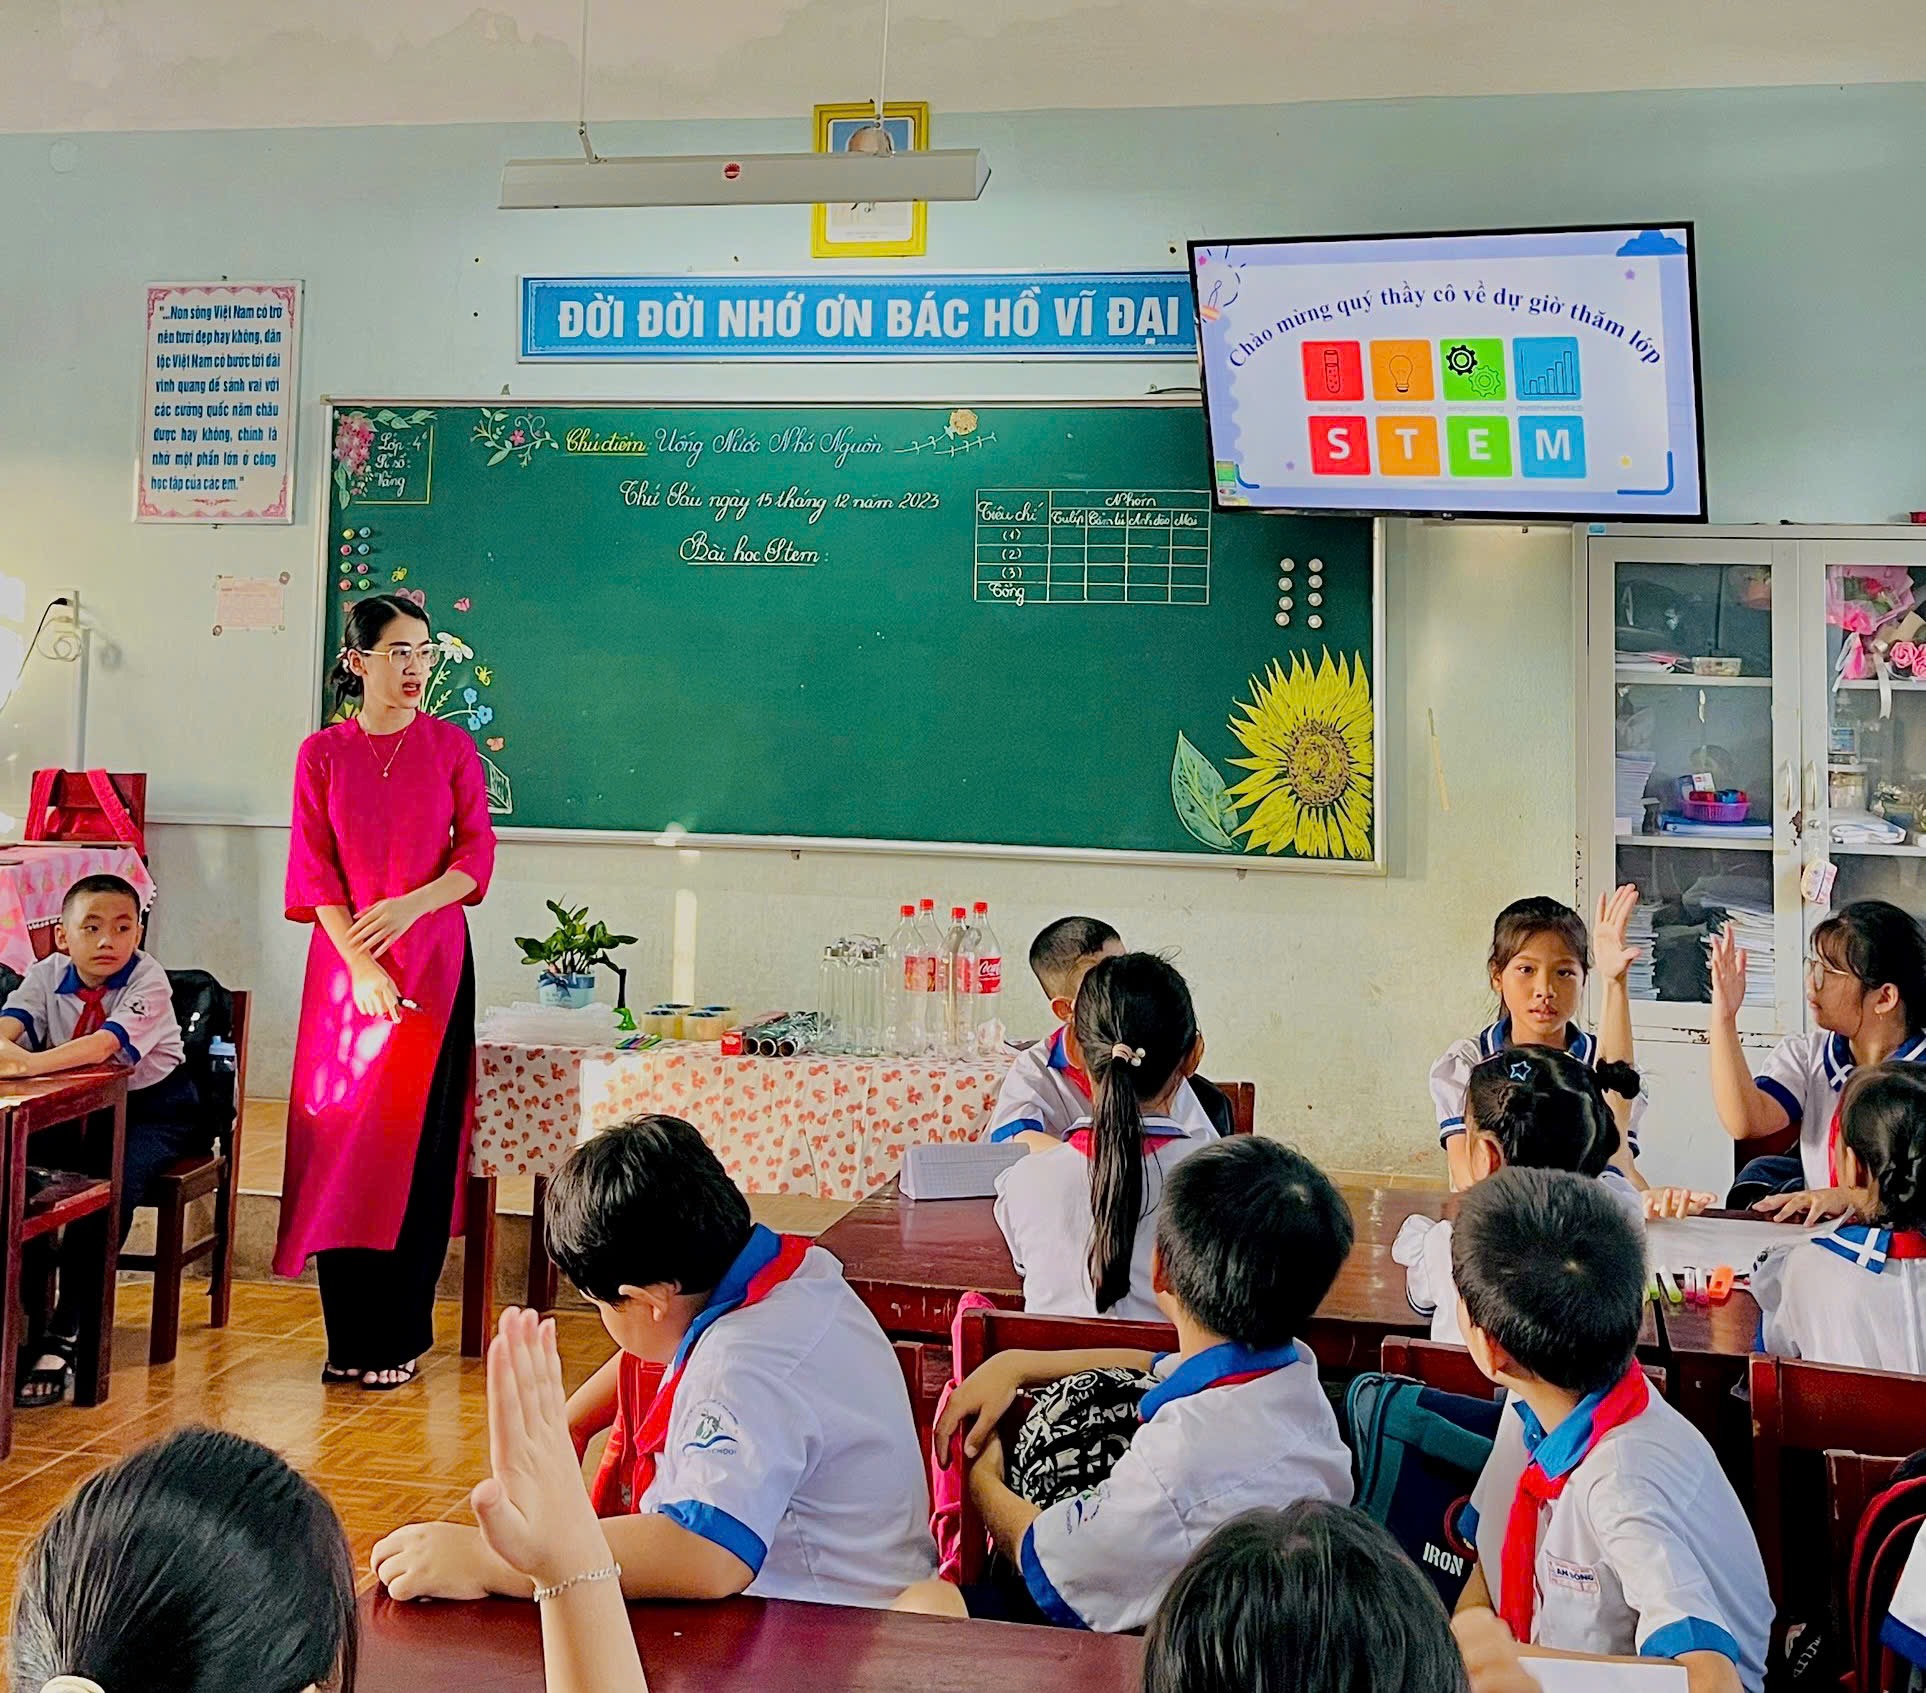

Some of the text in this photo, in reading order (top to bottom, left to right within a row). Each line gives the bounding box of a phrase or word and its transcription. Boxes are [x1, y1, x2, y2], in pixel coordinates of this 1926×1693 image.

[214, 305, 231, 321] Việt
[233, 305, 254, 319] Nam
[256, 304, 267, 319] có
[269, 302, 283, 319] trở
[557, 286, 1179, 345] ĐỜI ĐỜI NHỚ ƠN BÁC HỒ VĨ ĐẠI
[1228, 280, 1661, 367] Chào mừng quý thầy cô về dự giờ thăm lớp
[157, 329, 174, 343] nên
[176, 331, 194, 343] tươi
[214, 330, 230, 344] hay
[156, 354, 171, 371] tộc
[172, 354, 190, 371] Việt
[192, 354, 212, 368] Nam
[214, 353, 225, 368] có
[227, 352, 250, 368] bước
[252, 352, 264, 367] tới
[156, 379, 175, 392] vinh
[178, 381, 206, 394] quang
[223, 378, 245, 392] sánh
[248, 379, 262, 392] vai
[265, 378, 280, 392] với
[154, 401, 279, 418] các cường quốc năm châu
[181, 427, 197, 442] hay
[238, 426, 264, 441] chính
[268, 427, 278, 441] là
[566, 427, 600, 452] Chủ
[654, 428, 704, 468] Uống
[712, 427, 760, 454] Nước
[769, 426, 815, 454] Nhớ
[819, 426, 884, 468] Nguồn
[1327, 427, 1571, 461] S T E M
[175, 451, 193, 468] một
[223, 451, 239, 466] lớn
[253, 451, 277, 467] công
[151, 476, 168, 492] học
[169, 475, 183, 493] tập
[185, 474, 204, 490] của
[204, 476, 220, 490] các
[619, 480, 939, 524] Thứ Sáu ngày 15 tháng 12 năm 2023
[1105, 492, 1156, 506] Nhóm
[977, 501, 1044, 521] Tiêu chí
[1173, 513, 1198, 526] Mai
[1003, 528, 1021, 541] (1)
[680, 530, 725, 561] Bài
[1002, 547, 1022, 560] (2)
[1002, 566, 1022, 579] (3)
[1422, 1542, 1464, 1577] IRON
